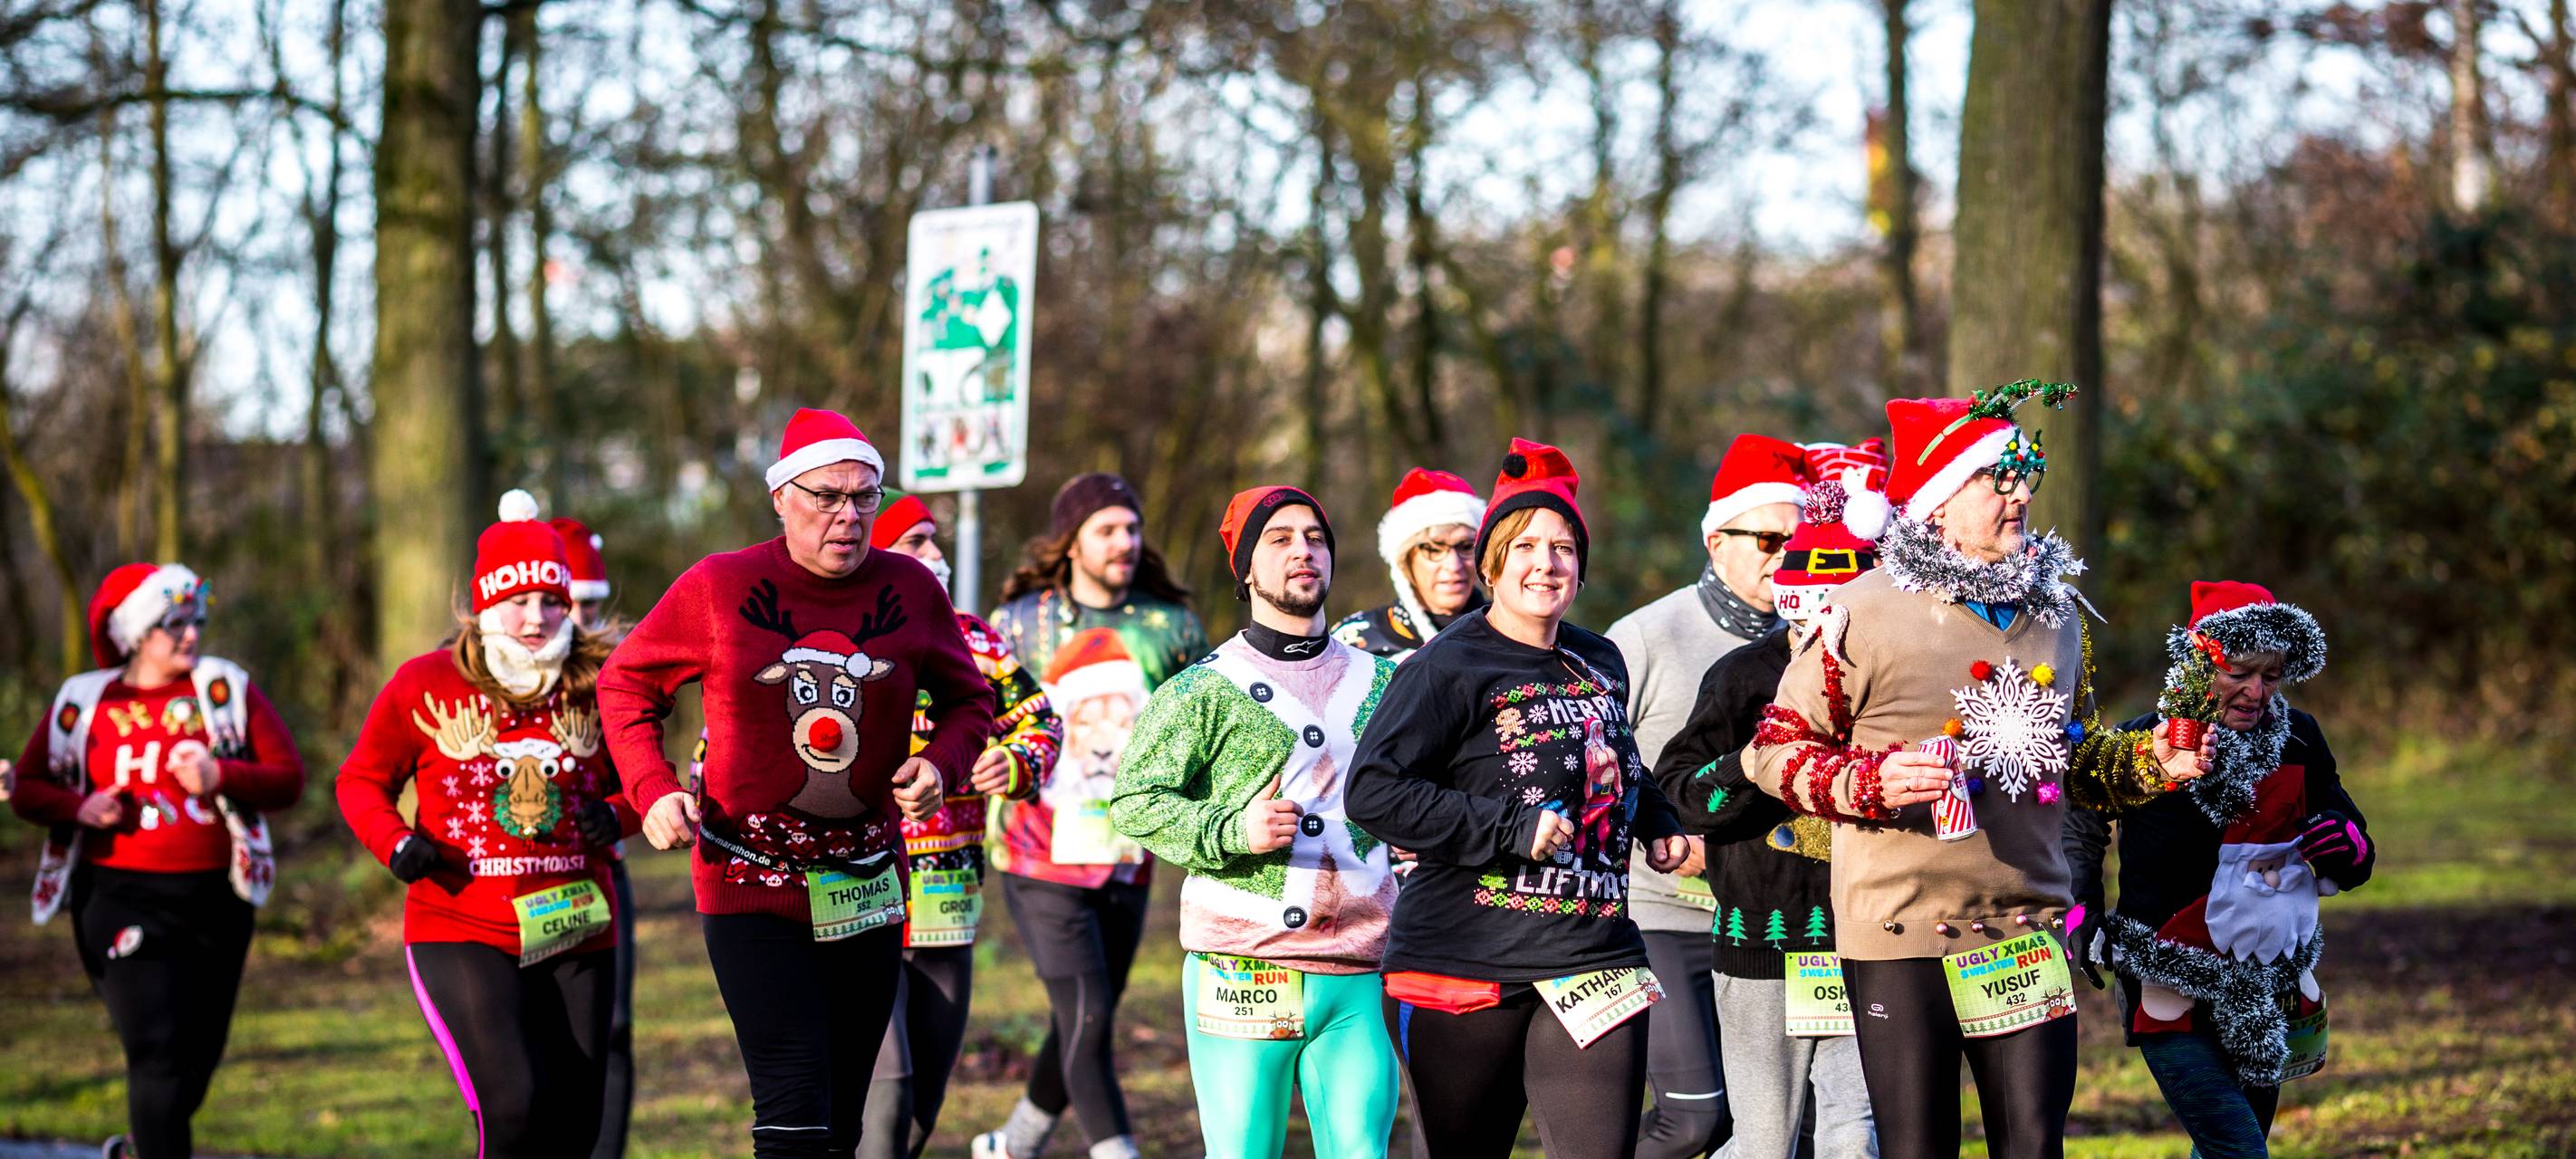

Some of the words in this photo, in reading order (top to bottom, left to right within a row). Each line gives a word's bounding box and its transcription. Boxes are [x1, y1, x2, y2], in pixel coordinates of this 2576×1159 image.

[1779, 594, 1800, 609] HO
[1547, 695, 1620, 724] MERRY
[828, 877, 889, 905] THOMAS
[857, 900, 871, 913] 552
[543, 911, 591, 935] CELINE
[1956, 946, 1999, 968] UGLY
[2003, 935, 2047, 957] XMAS
[2016, 946, 2053, 969] RUN
[1208, 954, 1239, 972] UGLY
[1798, 955, 1839, 967] UGLY
[1254, 972, 1289, 985] RUN
[1981, 969, 2041, 999] YUSUF
[1216, 987, 1278, 1004] MARCO
[1604, 983, 1623, 1000] 167
[2005, 992, 2027, 1006] 432
[1235, 1006, 1254, 1016] 251
